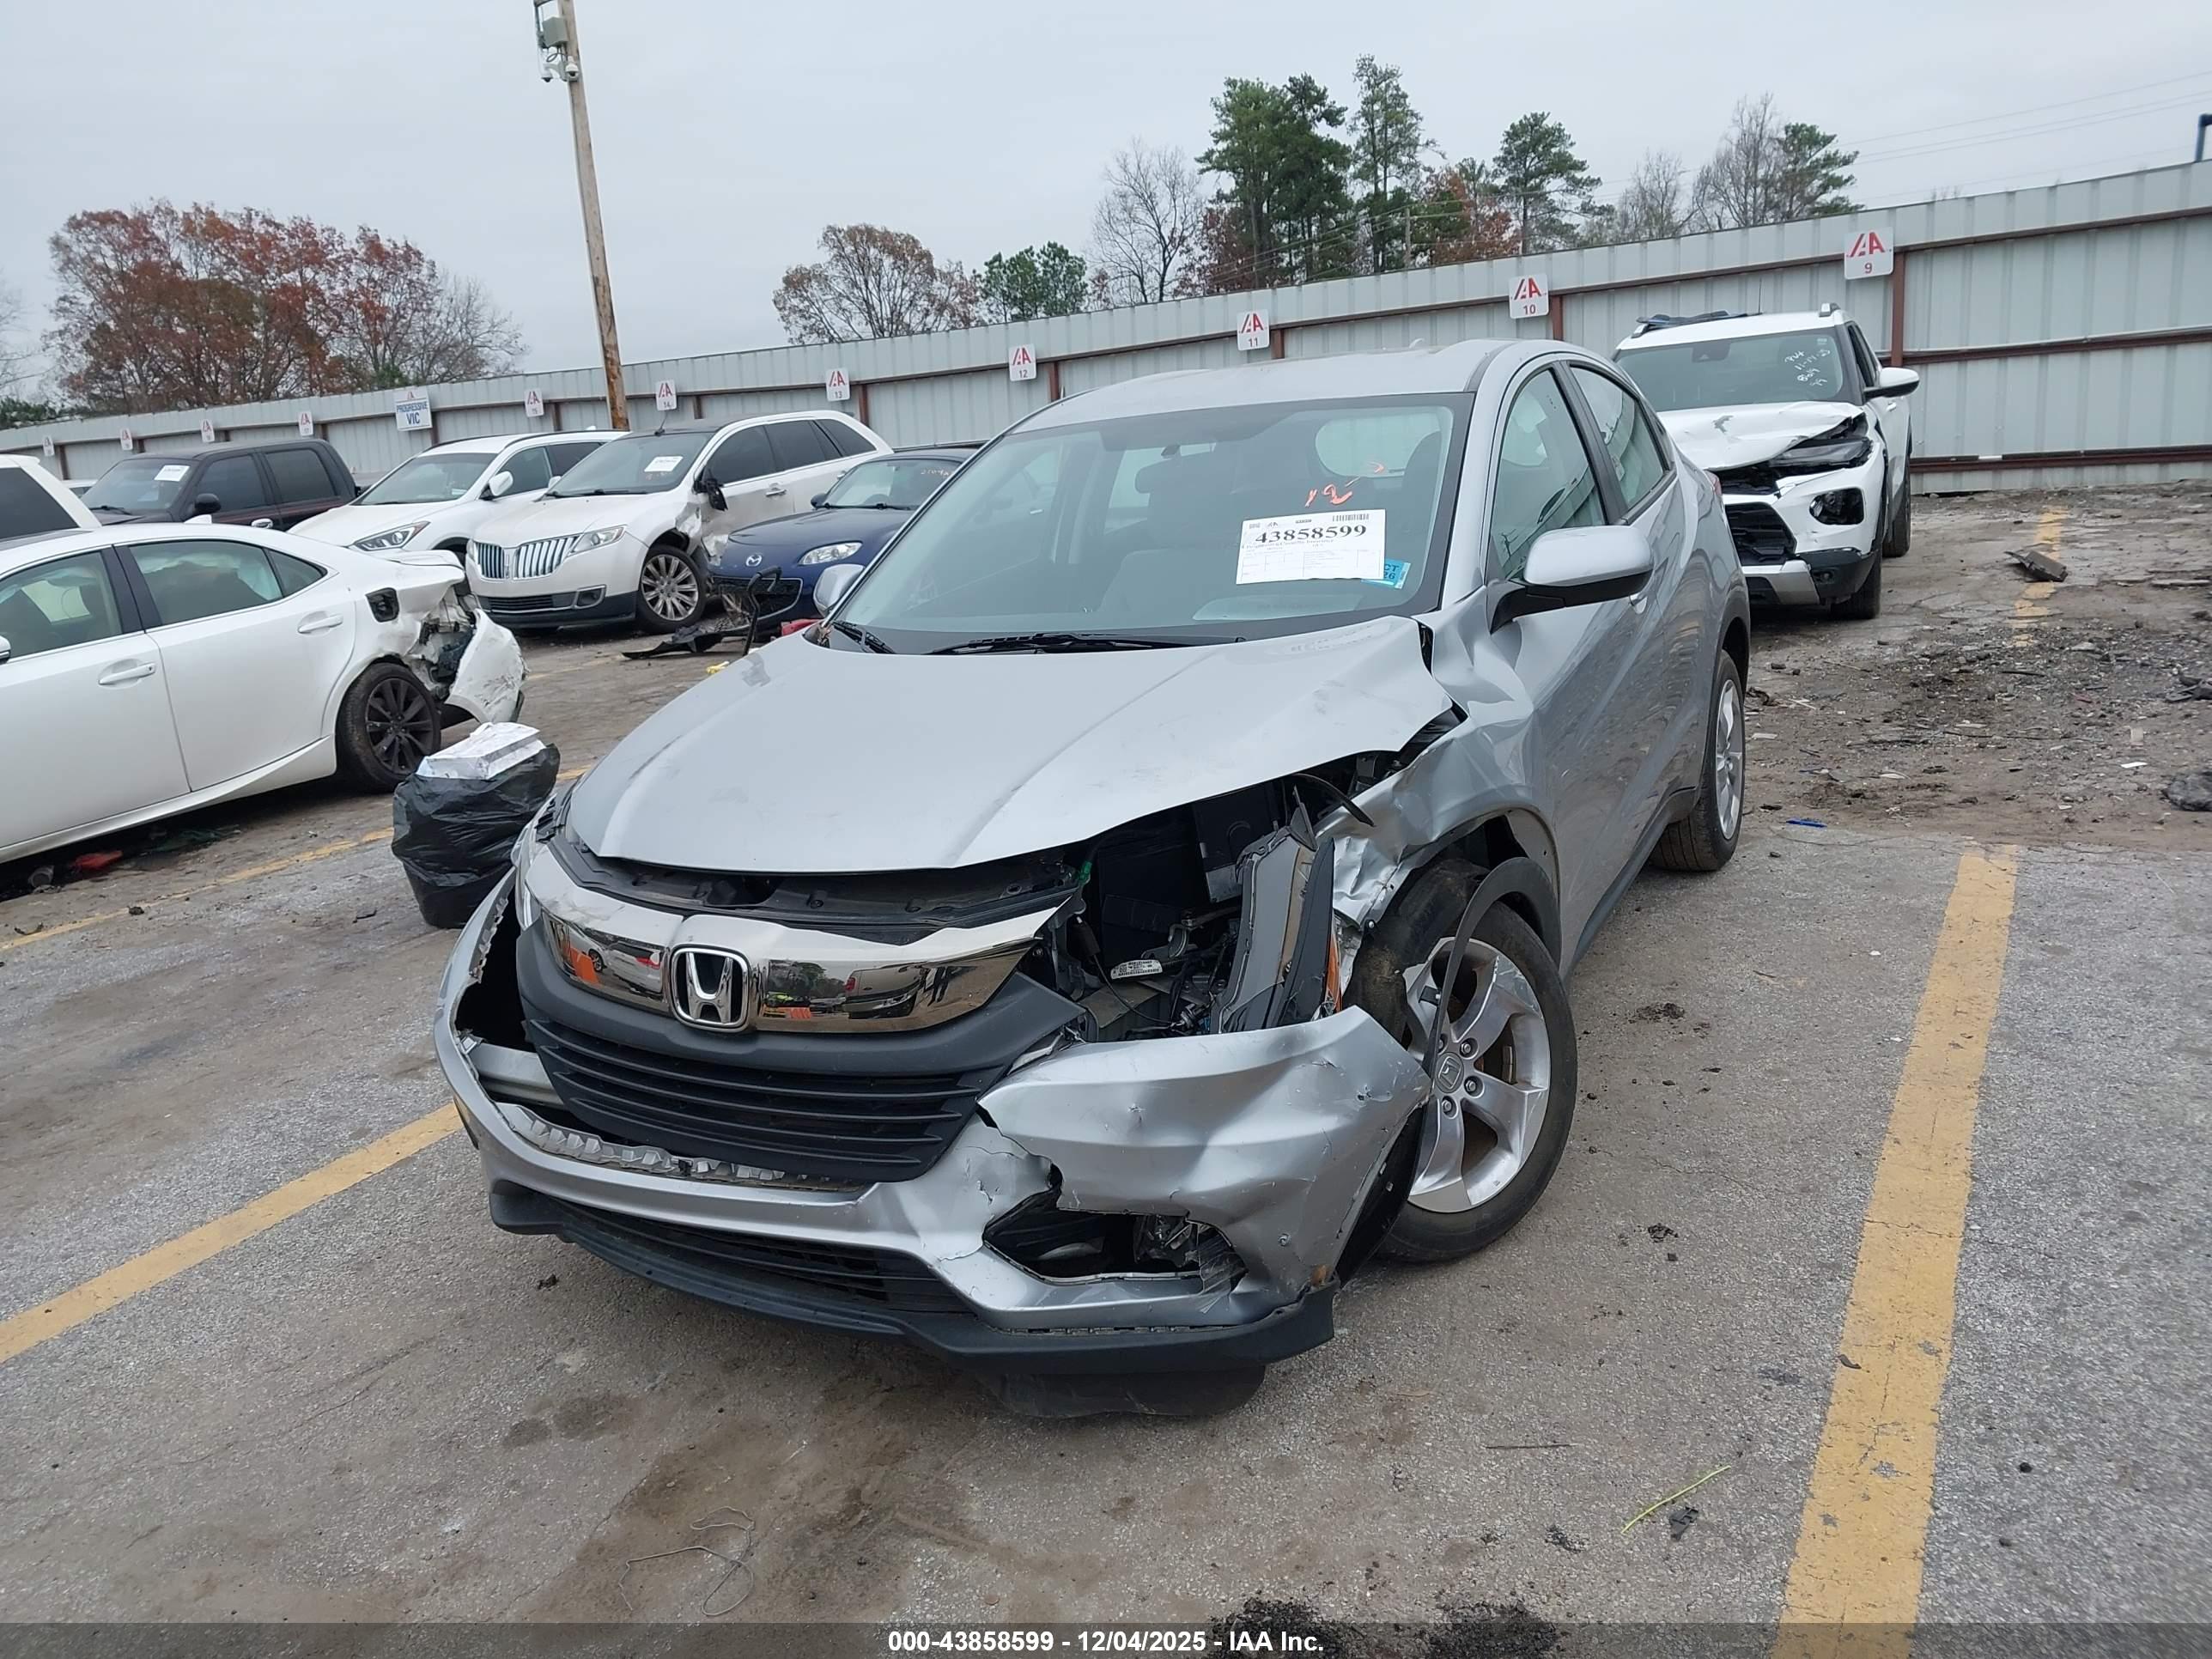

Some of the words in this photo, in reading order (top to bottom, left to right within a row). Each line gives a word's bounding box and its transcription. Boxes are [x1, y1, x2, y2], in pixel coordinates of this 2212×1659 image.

[1864, 263, 1873, 274] 9
[1523, 304, 1536, 315] 10
[1249, 337, 1258, 347] 11
[1019, 369, 1029, 379] 12
[835, 391, 843, 399] 13
[406, 412, 421, 425] VIC
[1255, 524, 1367, 544] 43858599
[1384, 563, 1400, 573] CT
